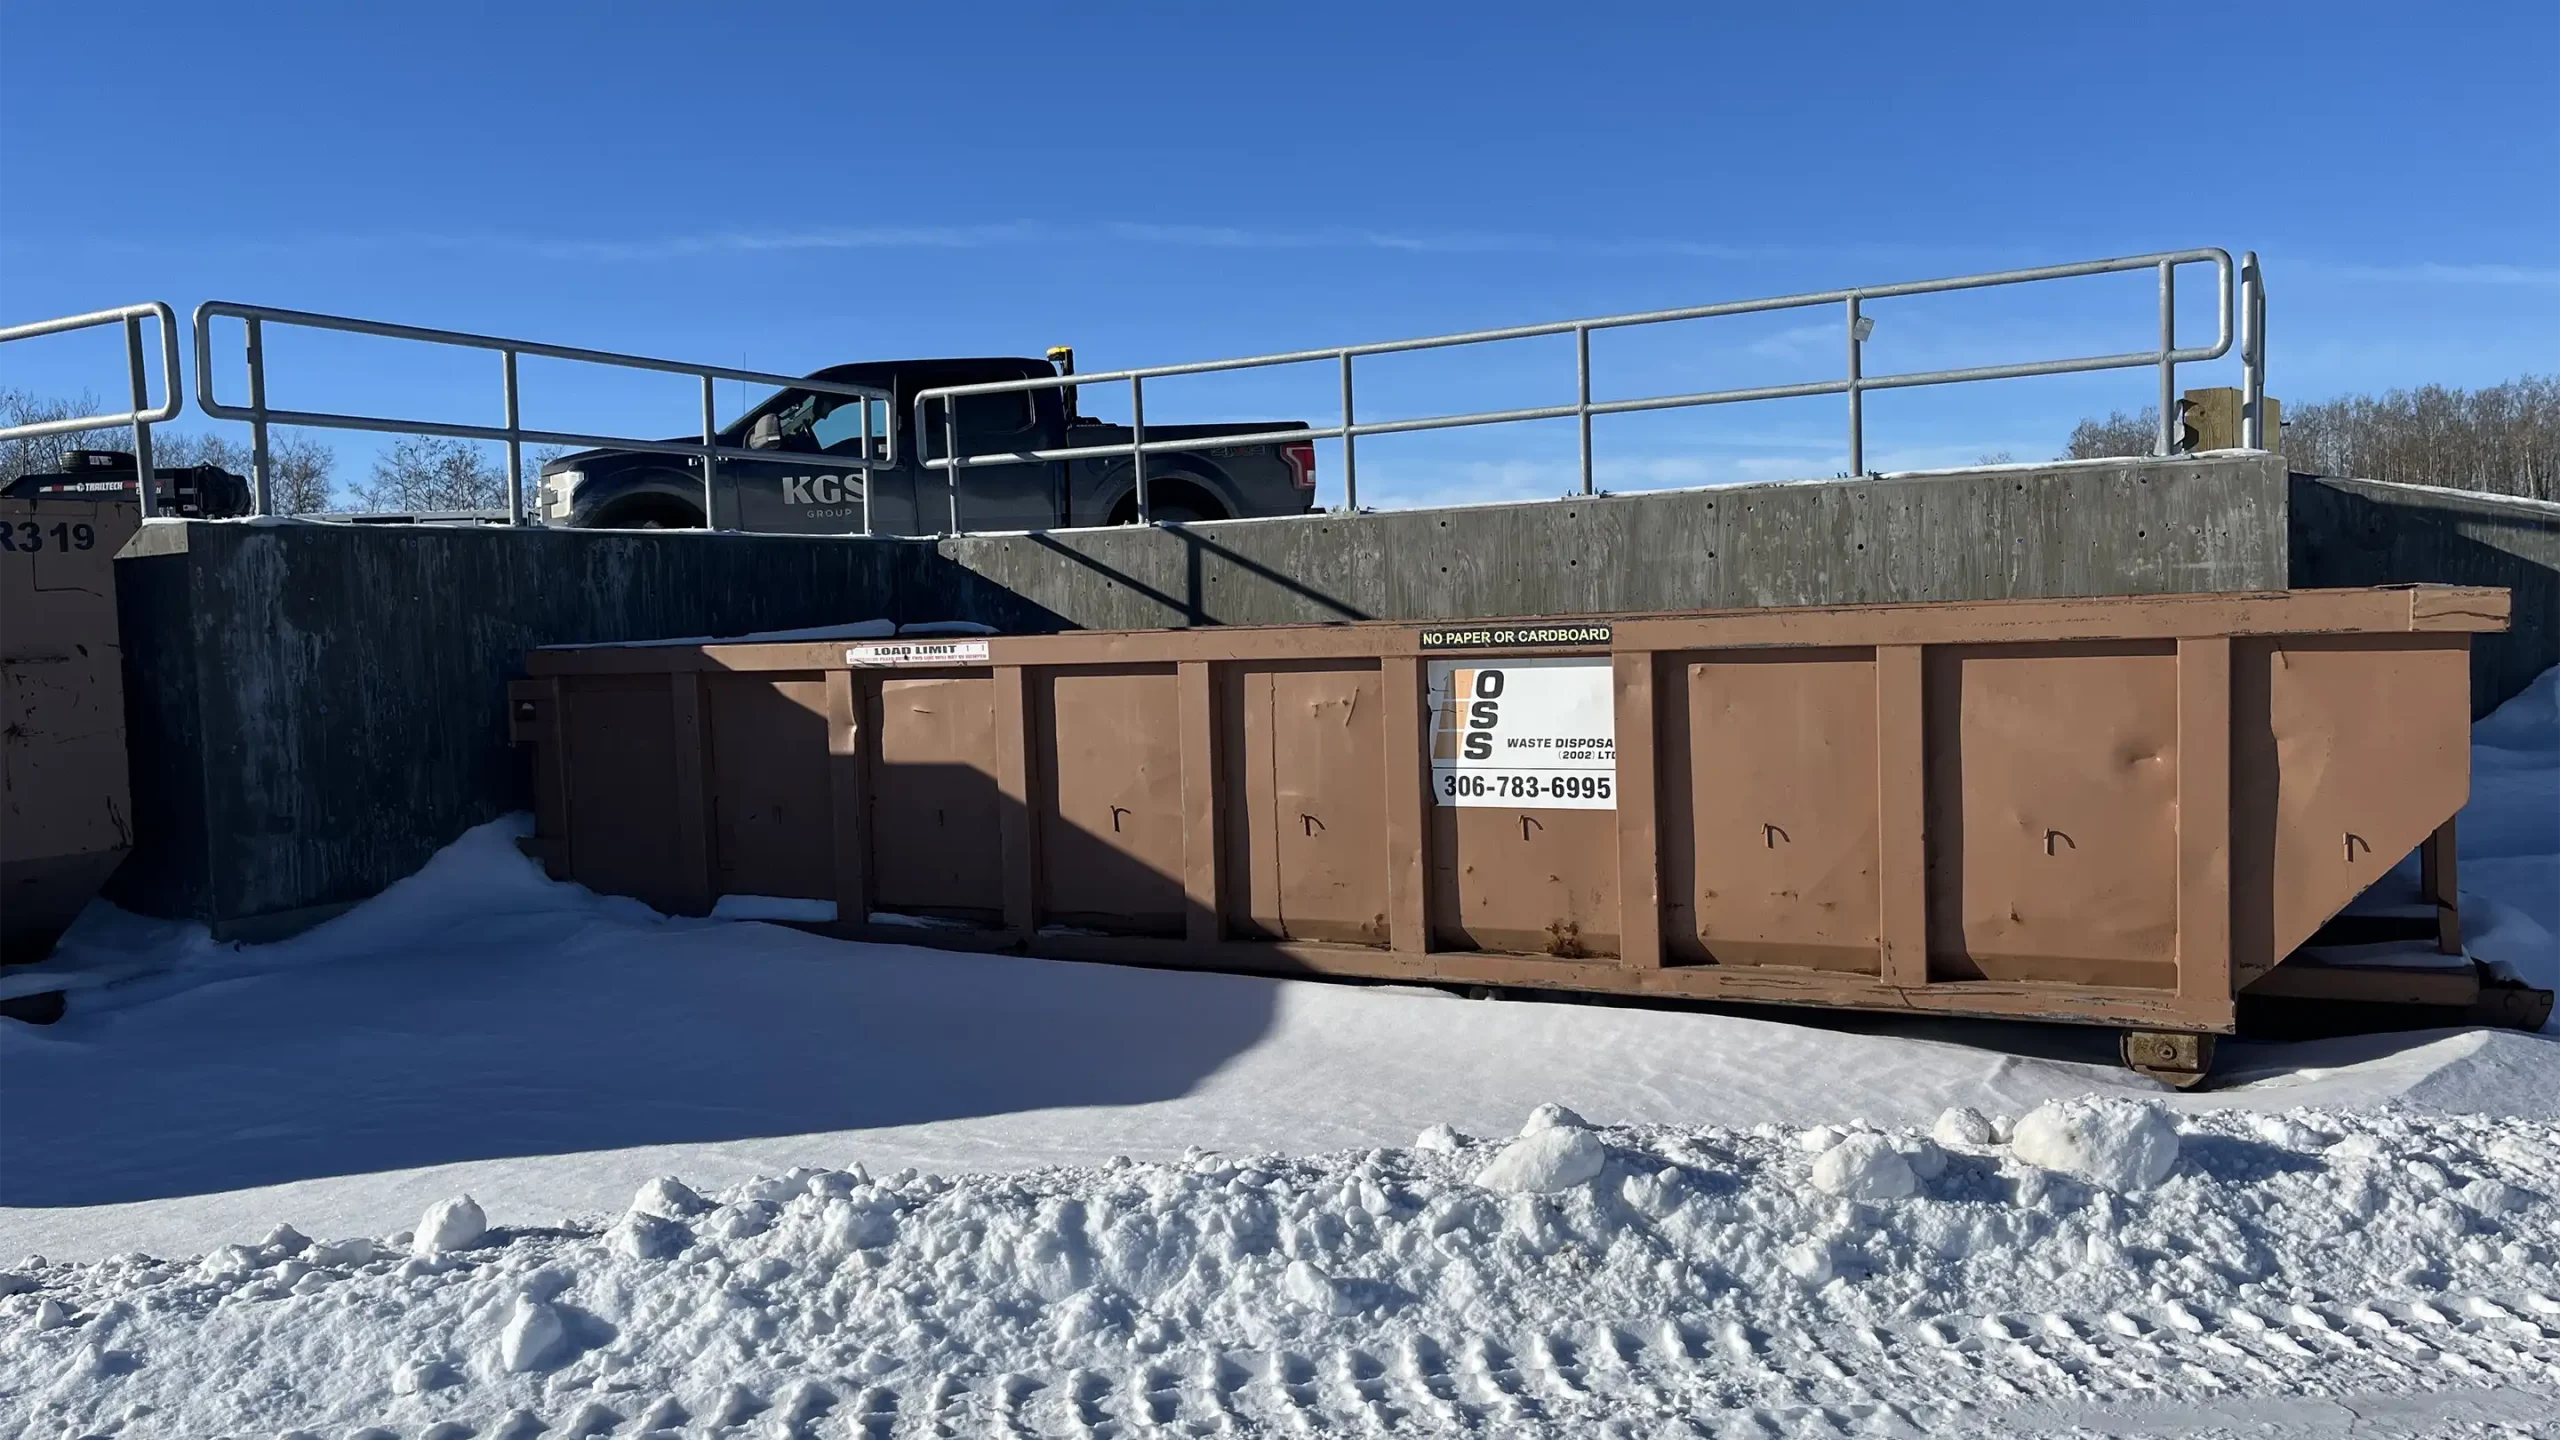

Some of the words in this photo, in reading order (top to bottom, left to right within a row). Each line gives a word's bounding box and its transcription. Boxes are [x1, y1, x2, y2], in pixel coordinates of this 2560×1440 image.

[85, 482, 123, 491] TRAILTECH
[782, 474, 866, 504] KGS
[807, 508, 852, 518] GROUP
[1423, 633, 1443, 645] NO
[1446, 631, 1491, 644] PAPER
[1494, 630, 1515, 643] OR
[1518, 628, 1610, 642] CARDBOARD
[874, 646, 911, 655] LOAD
[915, 645, 957, 654] LIMIT
[1507, 738, 1552, 748] WASTE
[1555, 738, 1614, 748] DISPOSA
[1558, 750, 1595, 760] (2002)
[1444, 775, 1611, 799] 306-783-6995
